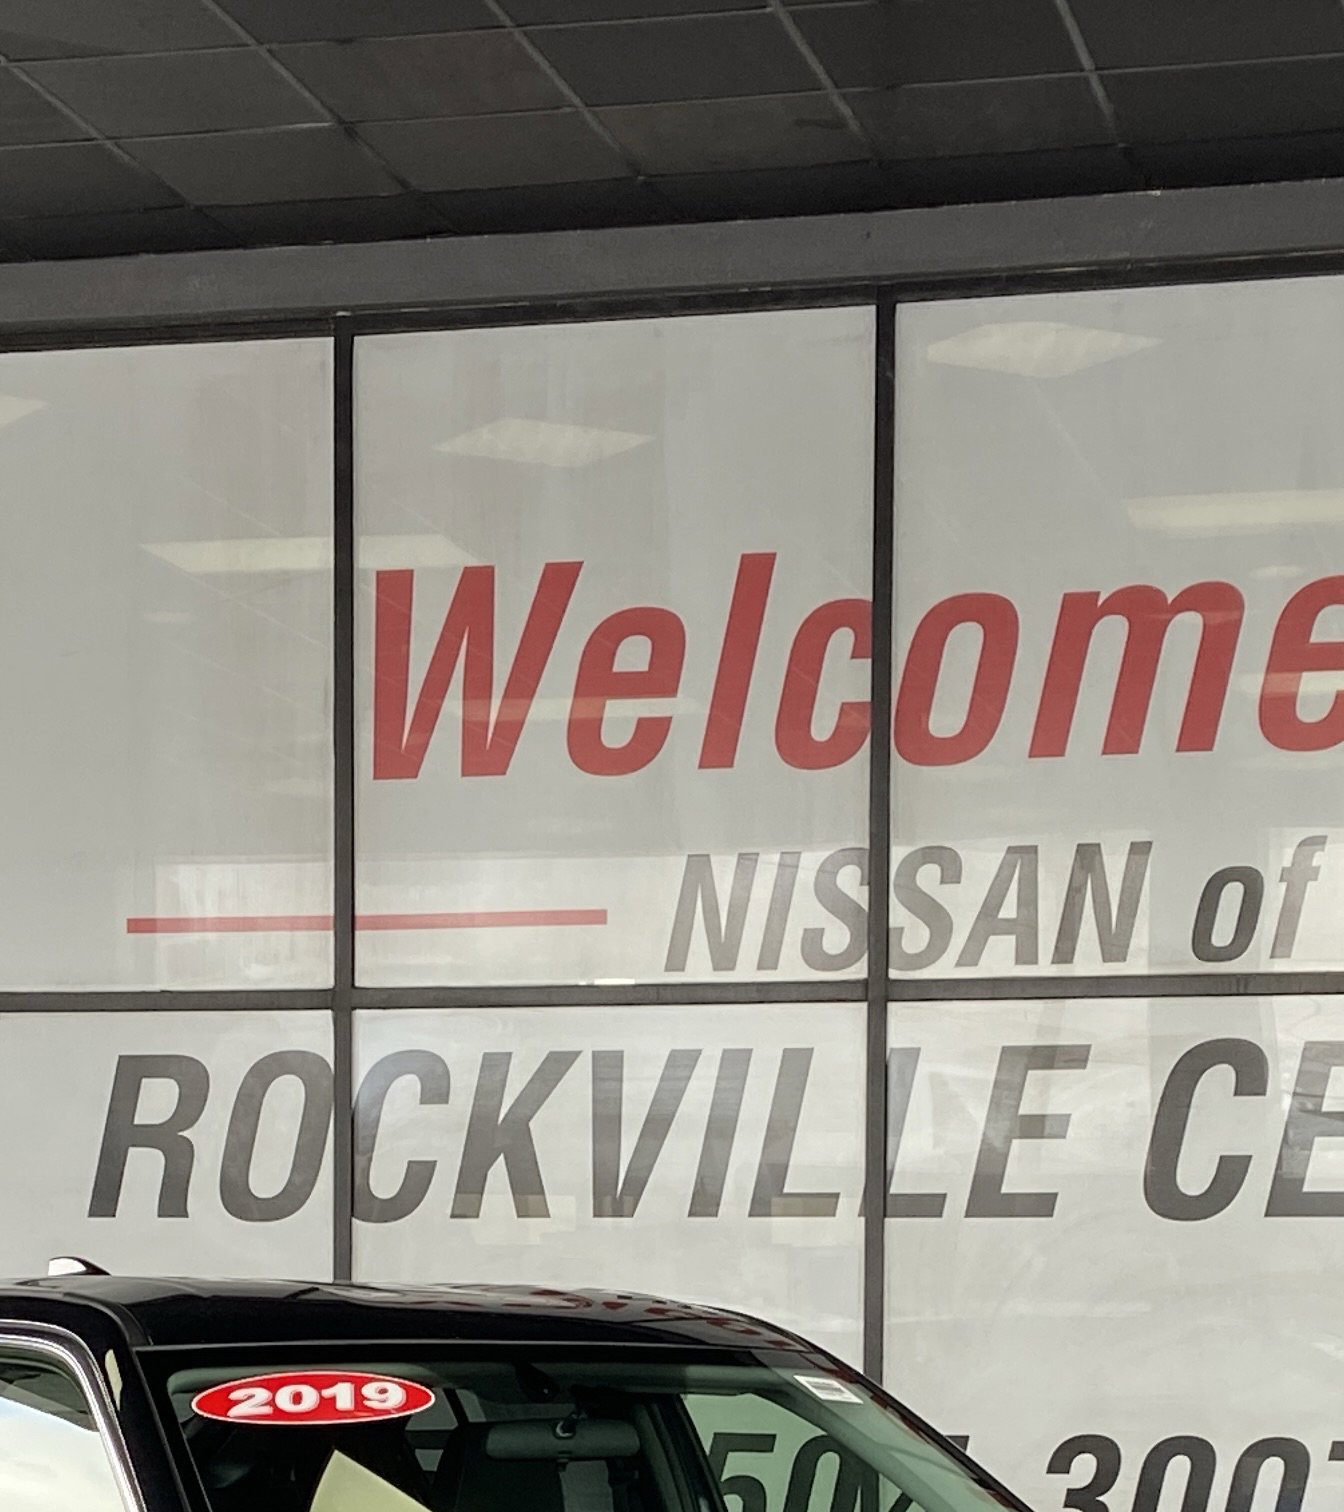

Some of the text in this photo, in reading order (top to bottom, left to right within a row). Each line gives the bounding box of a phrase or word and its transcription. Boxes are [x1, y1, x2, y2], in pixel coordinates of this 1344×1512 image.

[664, 835, 1328, 972] NISSAN of
[86, 1044, 1104, 1224] ROCKVILLE
[226, 1381, 407, 1418] 2019
